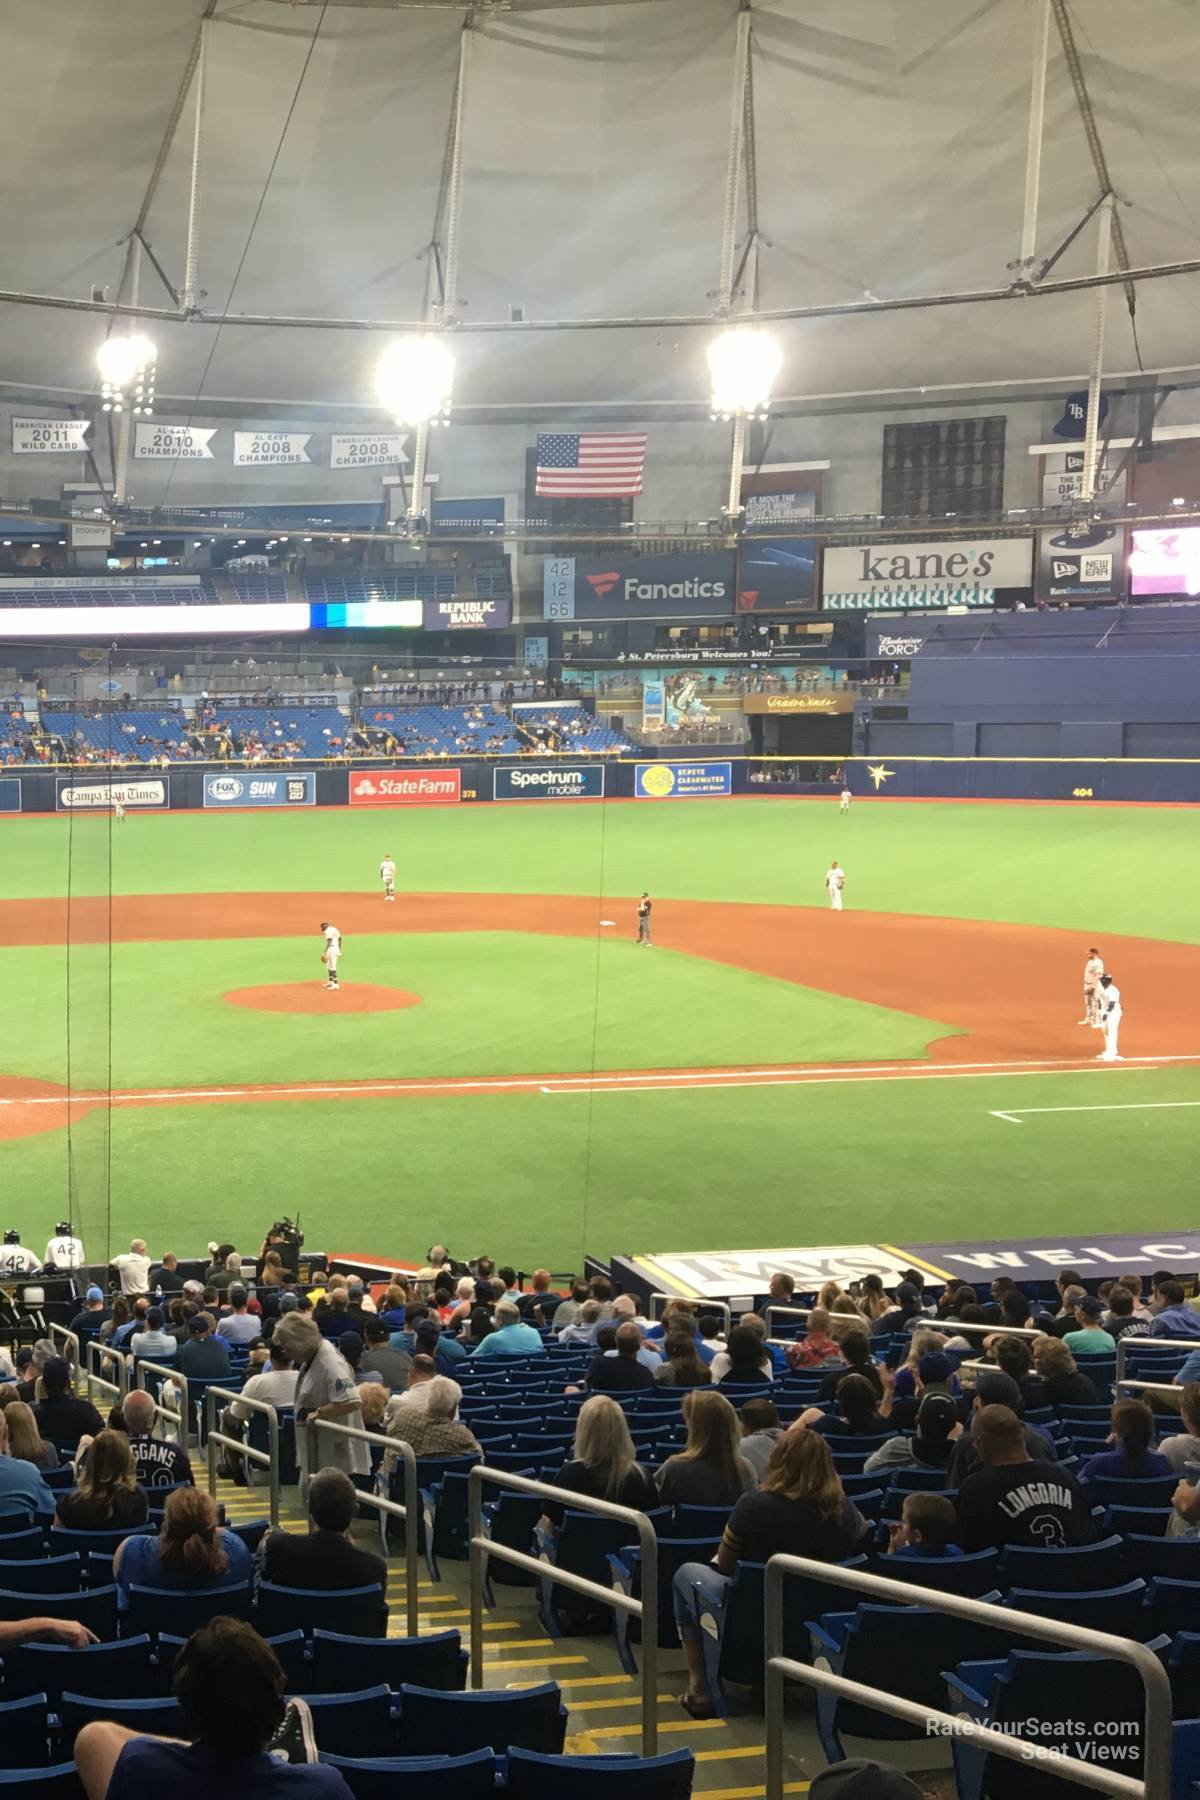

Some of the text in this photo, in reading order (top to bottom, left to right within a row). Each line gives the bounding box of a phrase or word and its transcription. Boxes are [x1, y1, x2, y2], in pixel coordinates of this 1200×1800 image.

[1068, 403, 1084, 419] TB
[32, 429, 69, 442] 2011
[153, 434, 193, 447] 2010
[21, 441, 78, 450] WILD CARD
[140, 446, 203, 457] CHAMPIONS
[250, 441, 291, 454] 2008
[348, 443, 389, 456] 2008
[239, 454, 301, 462] CHAMPIONS
[336, 455, 400, 465] CHAMPIONS
[1060, 476, 1074, 484] THE
[782, 494, 796, 502] THE
[75, 526, 108, 537] money
[550, 562, 569, 576] 42
[859, 548, 995, 581] kane's
[1085, 567, 1108, 576] ERA
[552, 582, 567, 596] 12
[624, 577, 726, 600] Fanatics
[871, 581, 981, 592] FURNITURE
[439, 601, 496, 614] REPUBLIC
[550, 602, 569, 616] 66
[450, 612, 484, 624] BANK
[628, 652, 642, 660] St.
[644, 651, 699, 661] Petersburg
[702, 650, 748, 658] Welcomes
[750, 649, 773, 658] You!
[878, 644, 920, 656] PORCH
[511, 770, 581, 788] Spectrum
[677, 776, 724, 784] CLEARWATER
[216, 783, 235, 791] FOX
[249, 781, 277, 794] SUN
[547, 785, 581, 795] mobile
[1072, 788, 1093, 797] 404
[66, 790, 102, 803] Tampa
[127, 787, 159, 800] Times
[57, 1243, 76, 1256] 42
[6, 1255, 25, 1271] 42
[942, 1244, 1200, 1269] WELC
[673, 1256, 895, 1284] RAYS
[998, 1482, 1072, 1518] LONGORIA
[1030, 1514, 1066, 1548] 3
